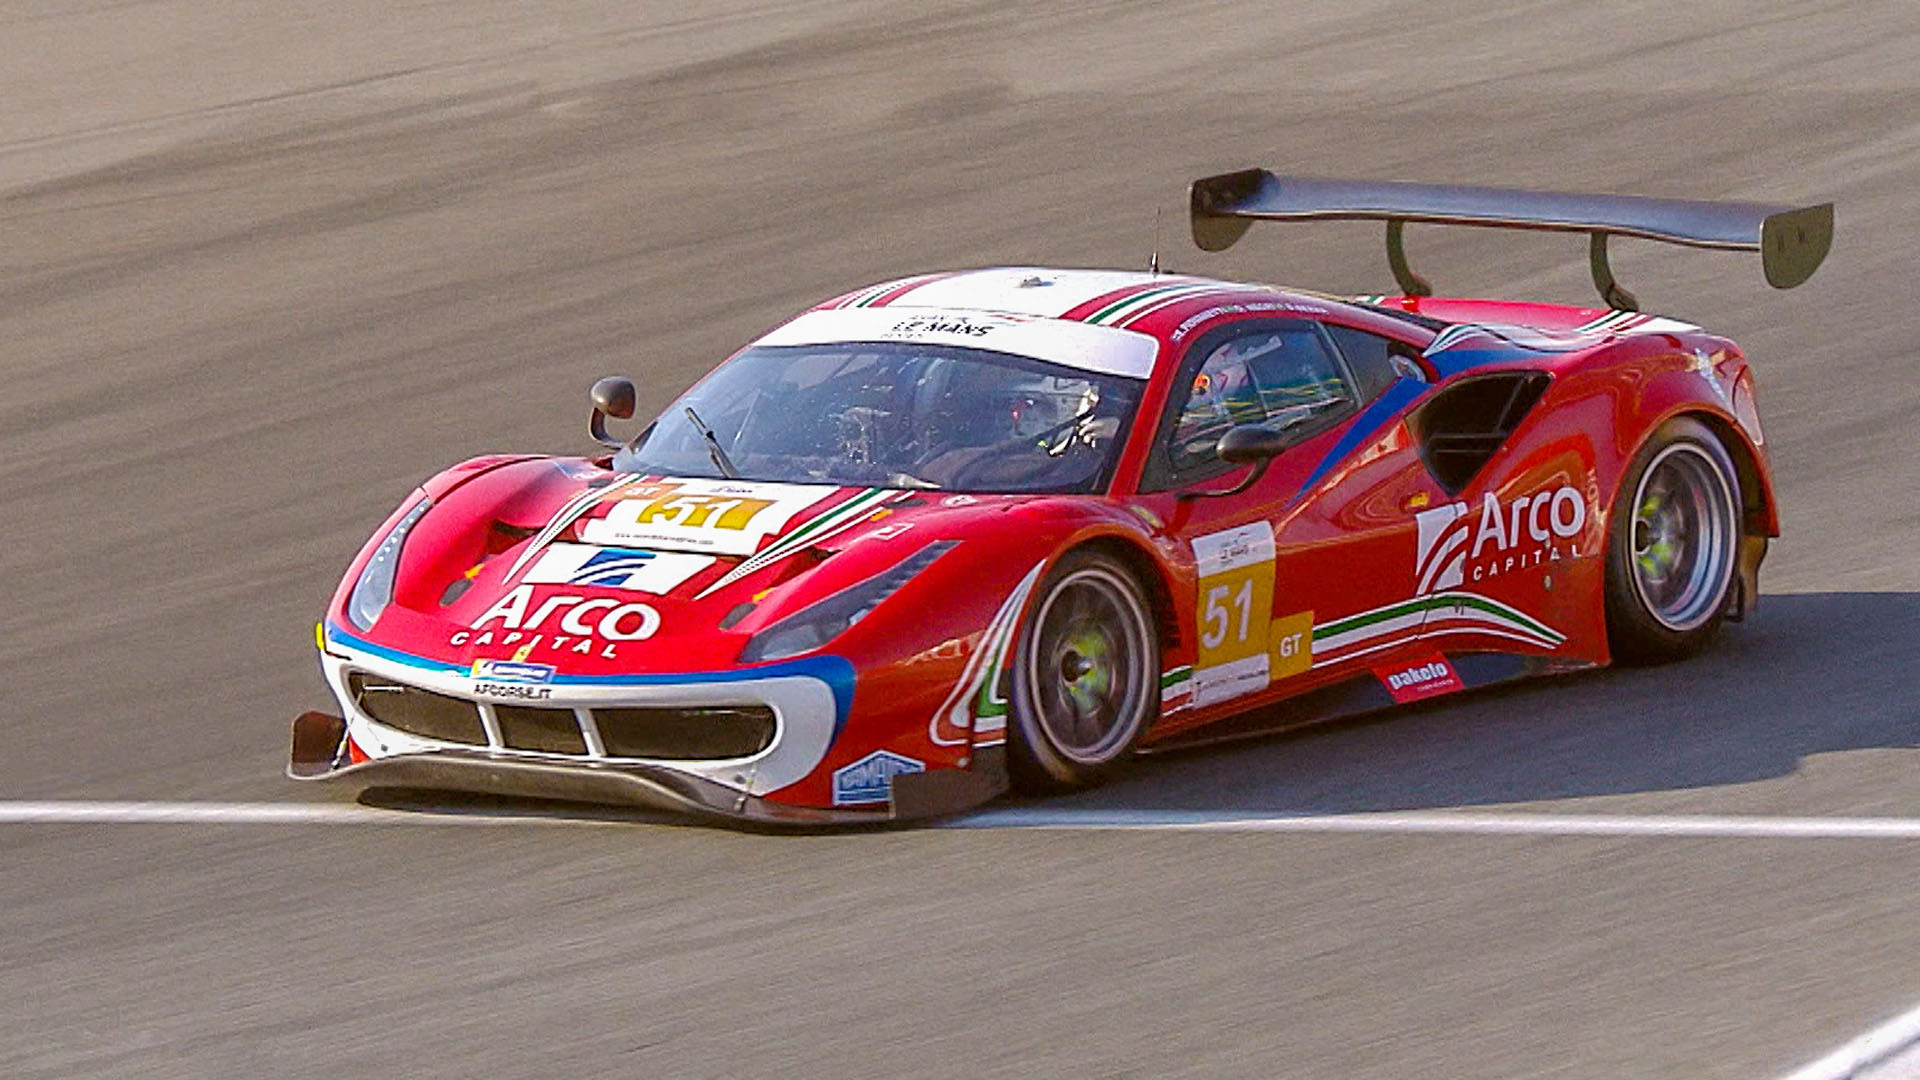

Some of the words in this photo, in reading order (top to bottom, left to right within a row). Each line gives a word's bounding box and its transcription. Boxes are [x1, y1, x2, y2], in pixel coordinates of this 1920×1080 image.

[650, 495, 743, 530] 51
[1472, 486, 1586, 560] Arco
[1473, 545, 1583, 581] CAPITAL
[469, 584, 662, 641] Arco
[1202, 578, 1253, 650] 51
[450, 631, 618, 660] CAPITAL
[1280, 632, 1303, 659] GT
